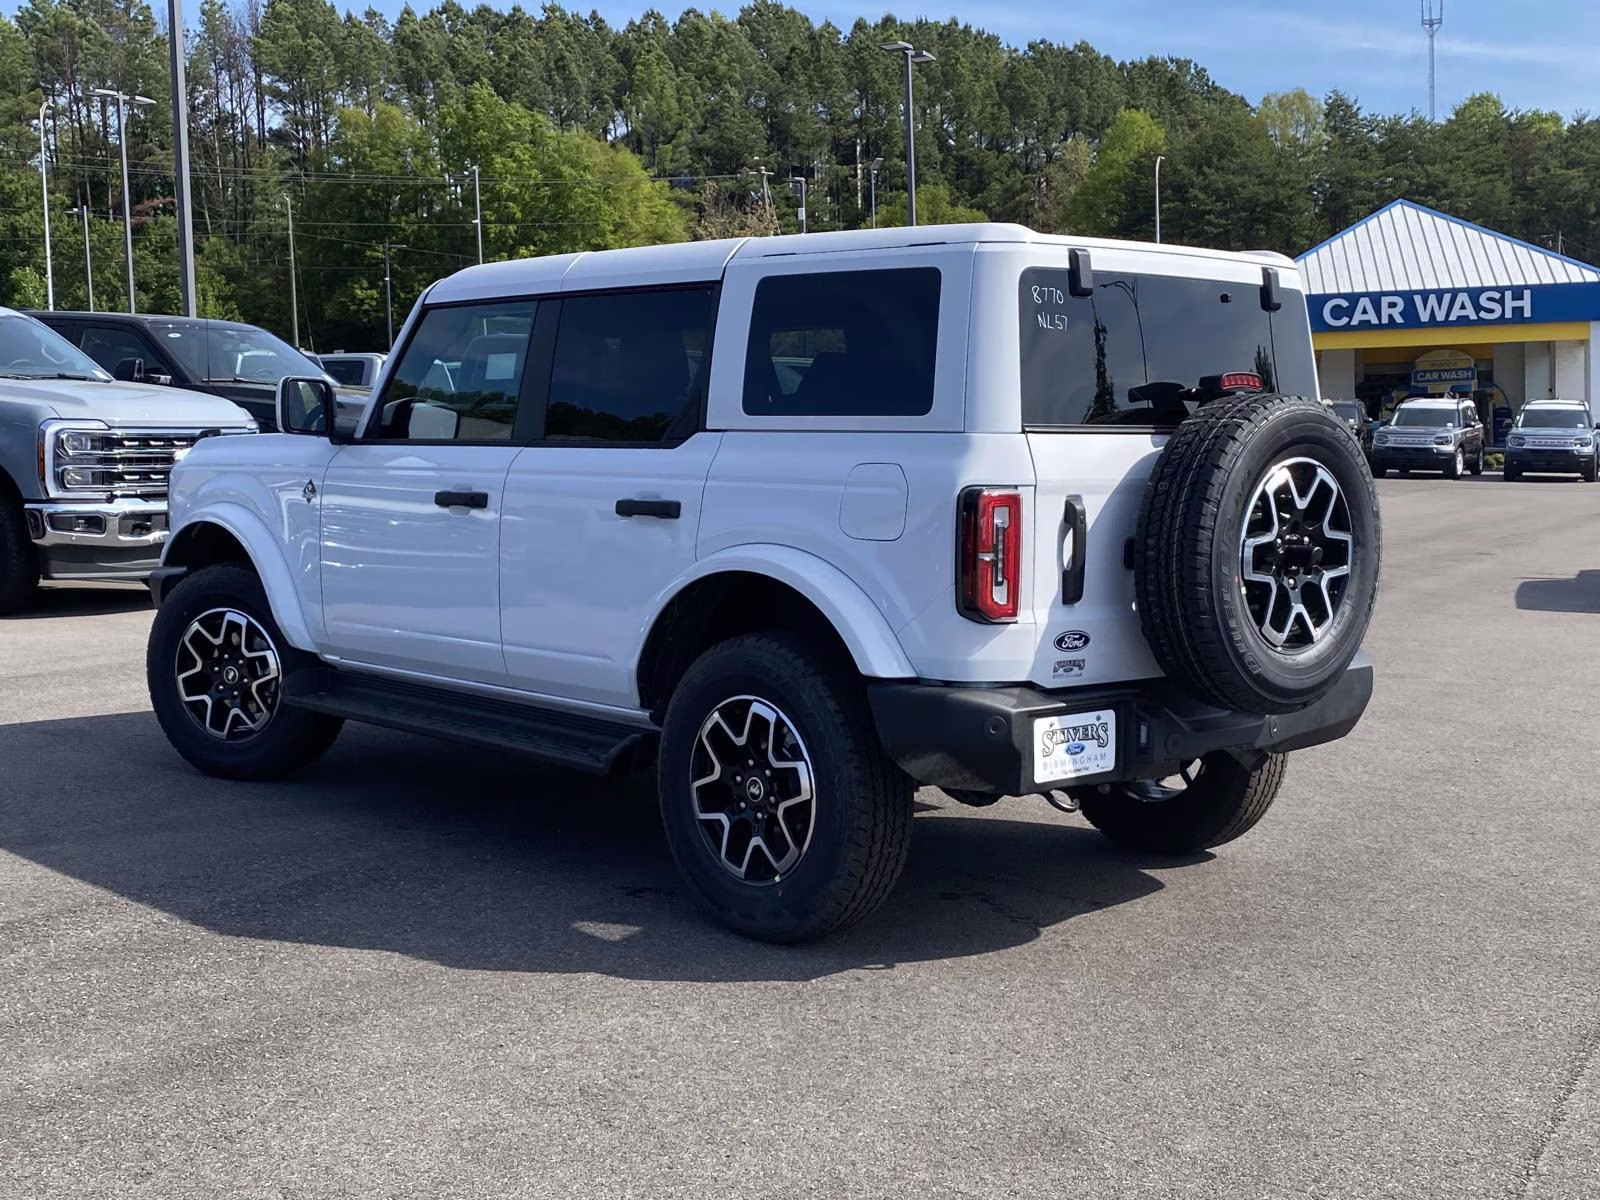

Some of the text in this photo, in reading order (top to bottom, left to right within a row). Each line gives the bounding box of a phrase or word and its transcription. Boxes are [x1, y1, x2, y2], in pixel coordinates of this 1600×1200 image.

[1032, 285, 1064, 304] 8770
[1323, 290, 1532, 327] CAR WASH
[1037, 312, 1068, 332] NL57
[1417, 370, 1473, 380] CAR WASH
[1060, 633, 1086, 649] Ford
[1042, 722, 1108, 757] STIVERS
[1066, 743, 1085, 755] Ford
[1043, 752, 1107, 770] BIRMINGHAM
